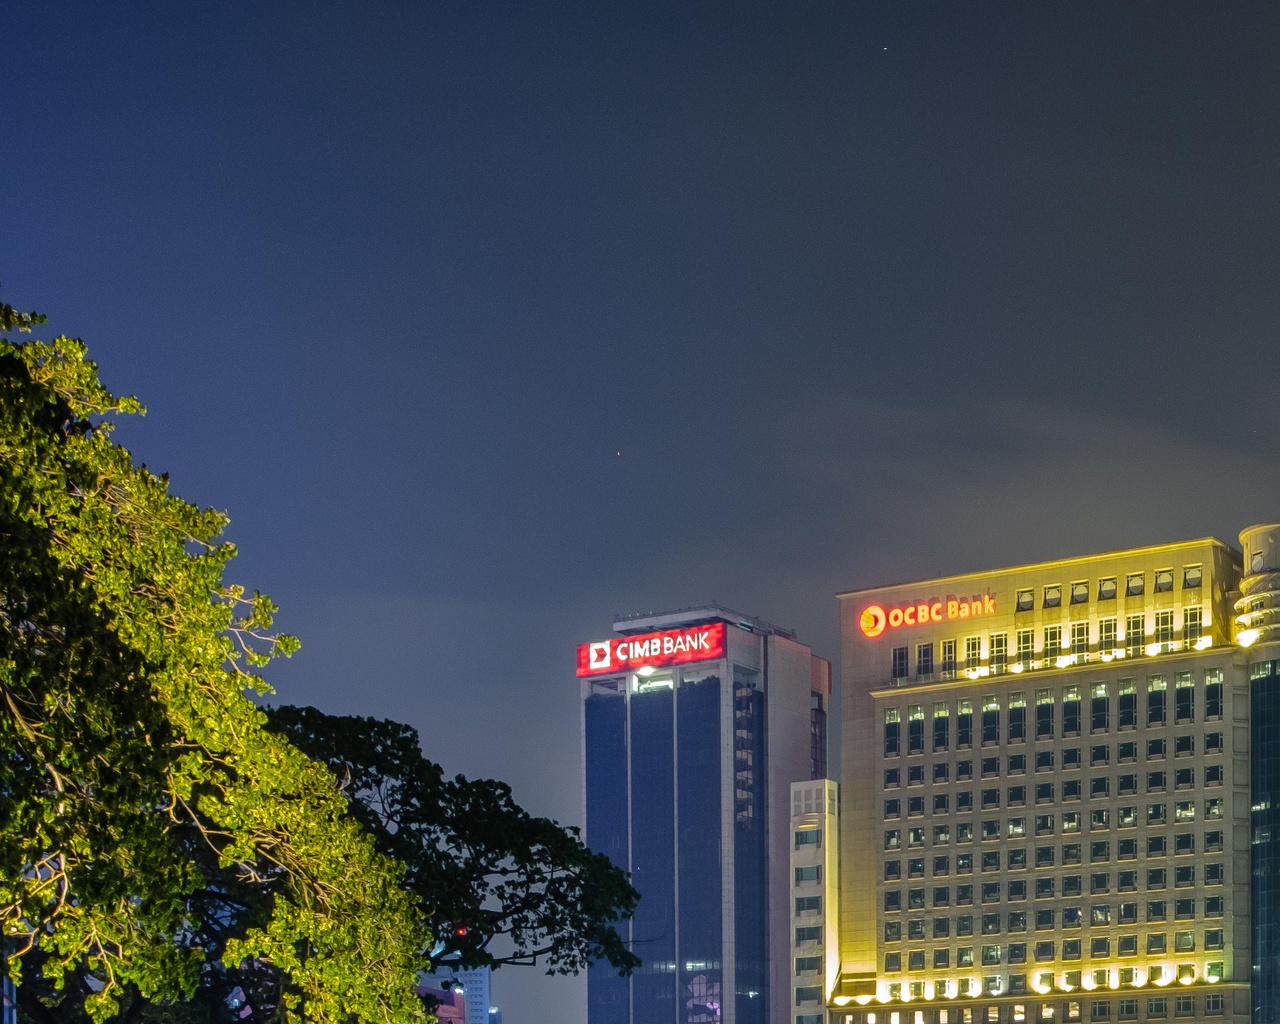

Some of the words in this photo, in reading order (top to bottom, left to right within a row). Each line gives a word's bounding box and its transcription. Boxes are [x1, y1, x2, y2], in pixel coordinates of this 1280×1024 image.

[889, 602, 943, 627] OCBC
[947, 594, 996, 619] Bank
[616, 638, 662, 661] CIMB
[664, 631, 710, 655] BANK
